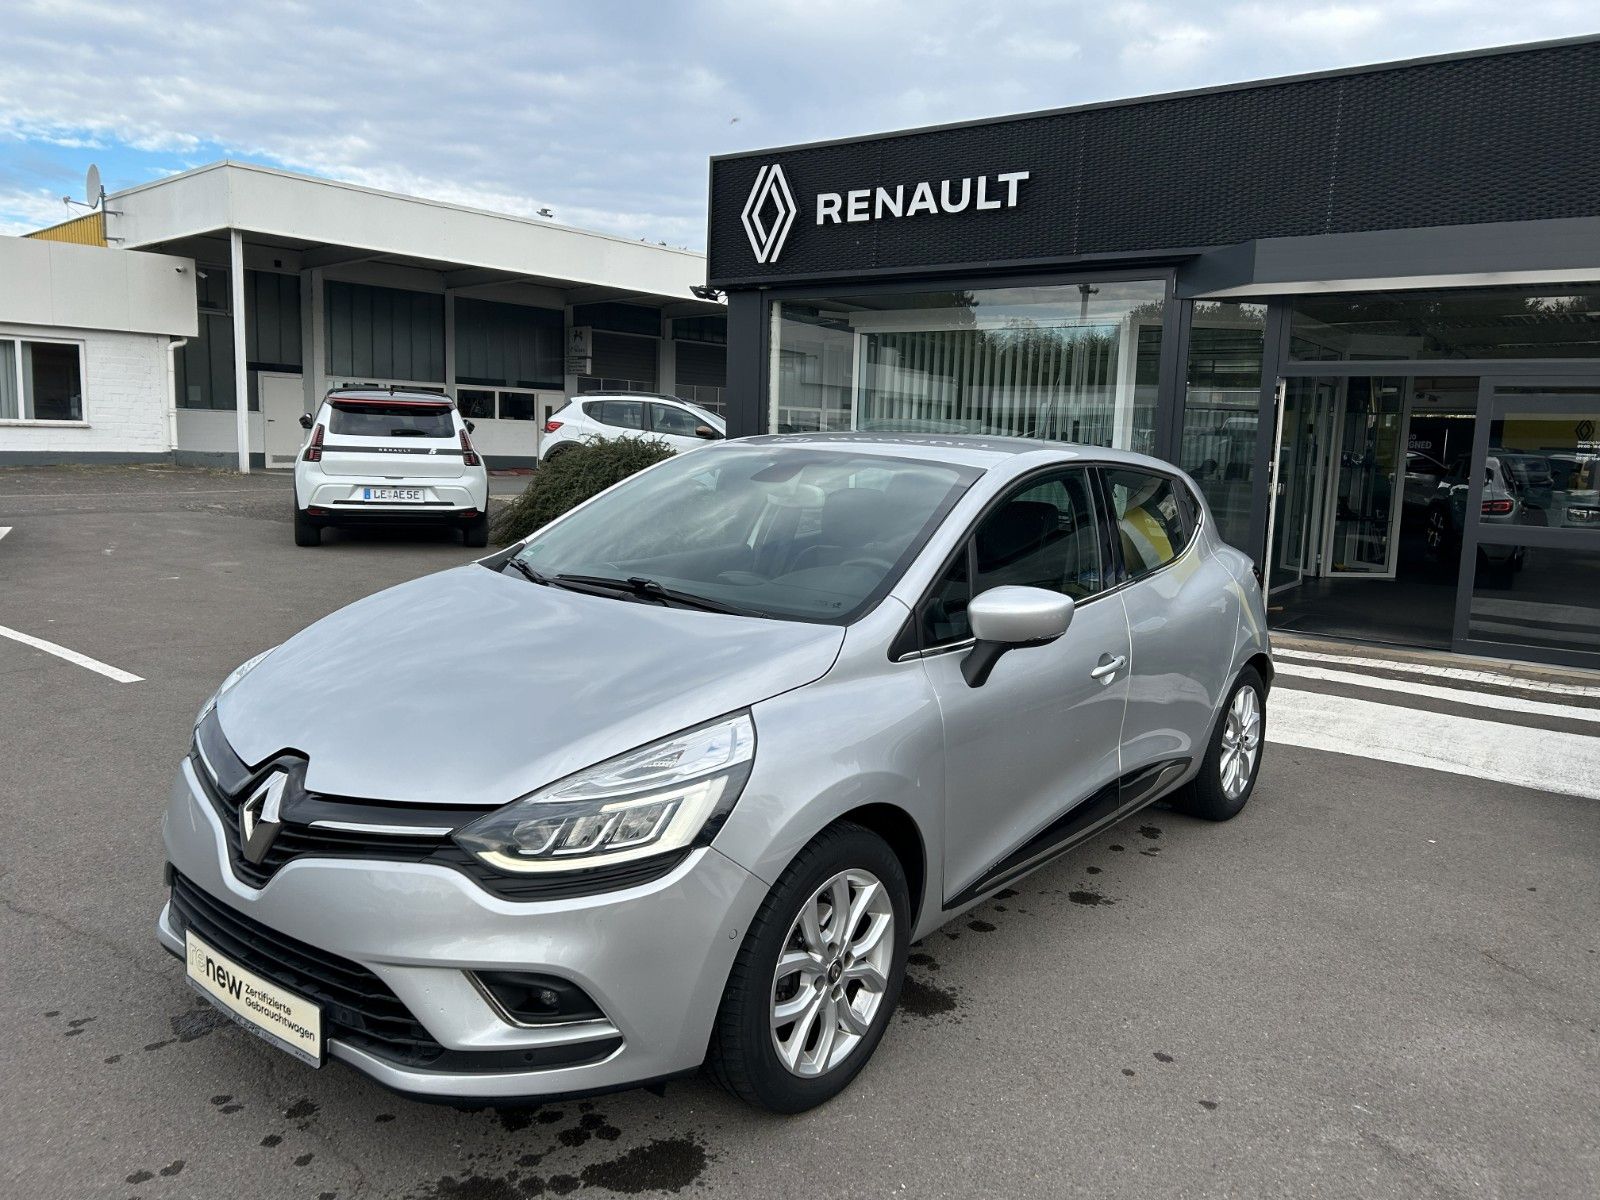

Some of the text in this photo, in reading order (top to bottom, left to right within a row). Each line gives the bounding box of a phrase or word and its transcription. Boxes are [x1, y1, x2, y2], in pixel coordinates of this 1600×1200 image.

[816, 171, 1030, 225] RENAULT
[373, 489, 387, 498] LE
[245, 983, 292, 1016] Zertifizierte
[245, 997, 315, 1042] Gebrauchtwagen
